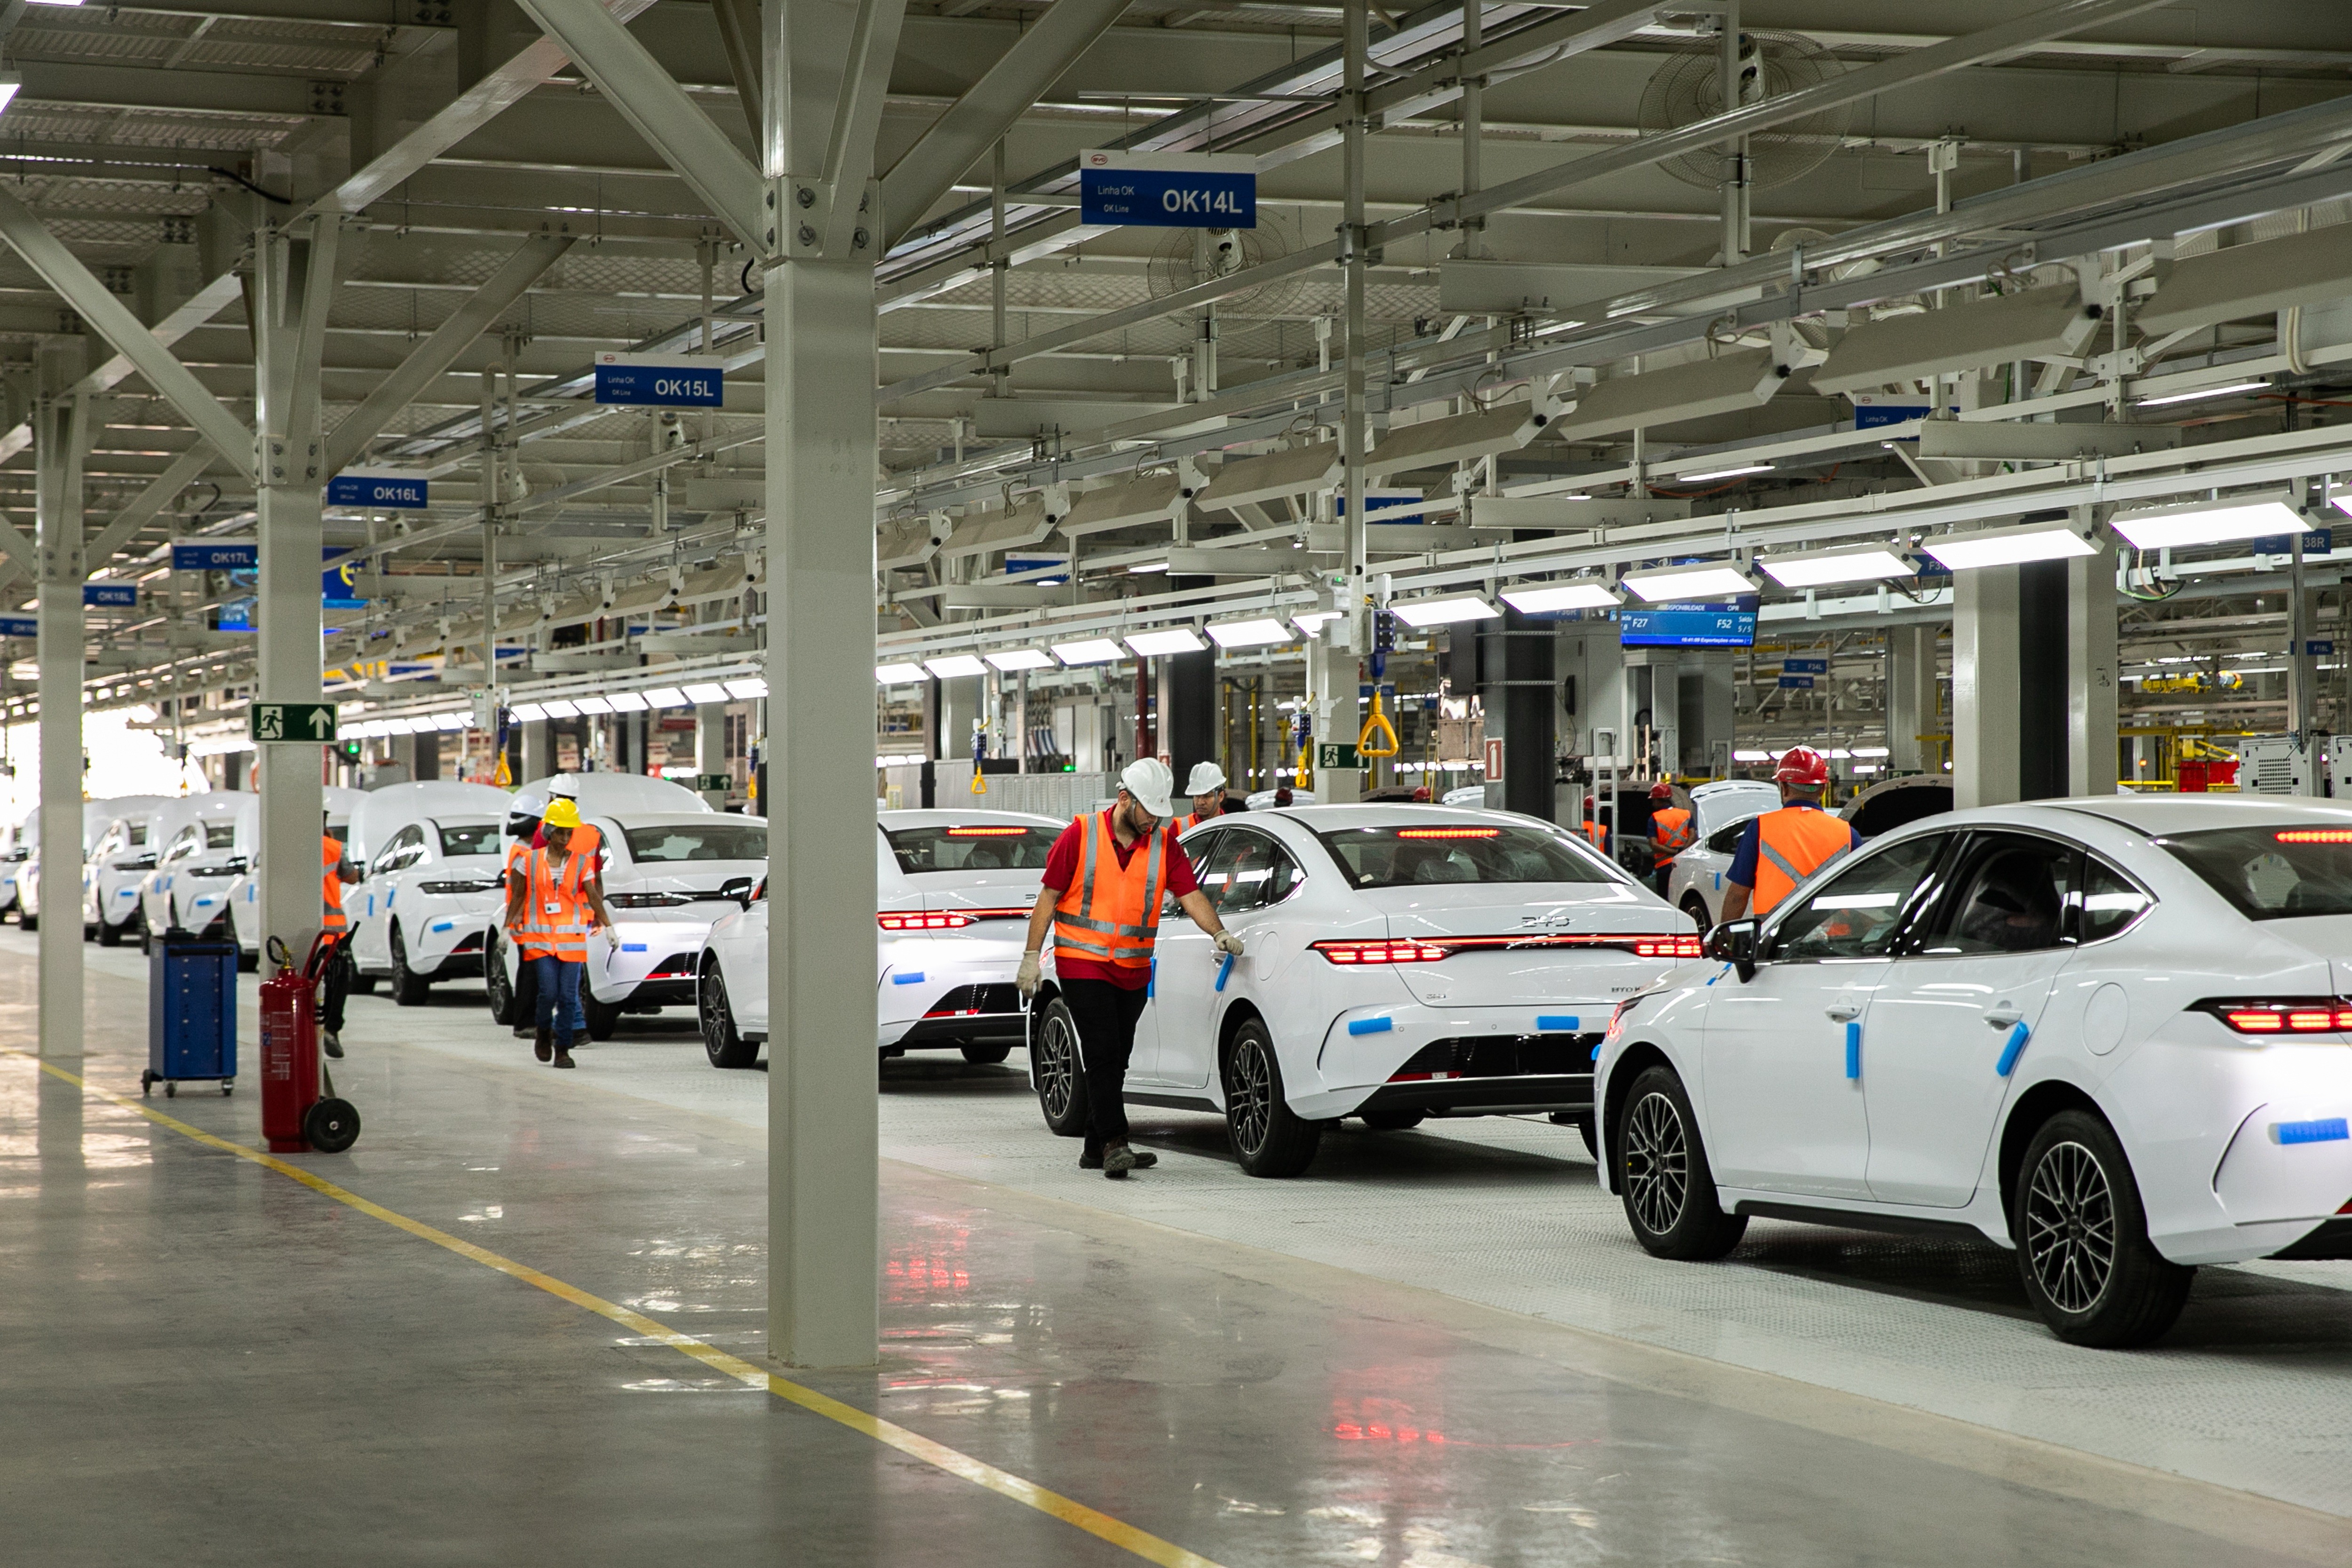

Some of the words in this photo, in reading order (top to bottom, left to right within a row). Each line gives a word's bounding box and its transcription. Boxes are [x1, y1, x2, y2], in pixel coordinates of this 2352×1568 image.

[1097, 185, 1120, 195] Linha
[1121, 185, 1135, 196] OK
[1162, 189, 1243, 214] OK14L
[1104, 204, 1114, 213] OK
[1115, 204, 1129, 213] Line
[655, 379, 714, 397] OK15L
[373, 487, 421, 501] OK16L
[2303, 537, 2325, 548] 38R
[211, 552, 251, 564] OK17L
[1632, 618, 1648, 628] F27
[1717, 619, 1732, 629] F52
[1522, 916, 1570, 927] BYD
